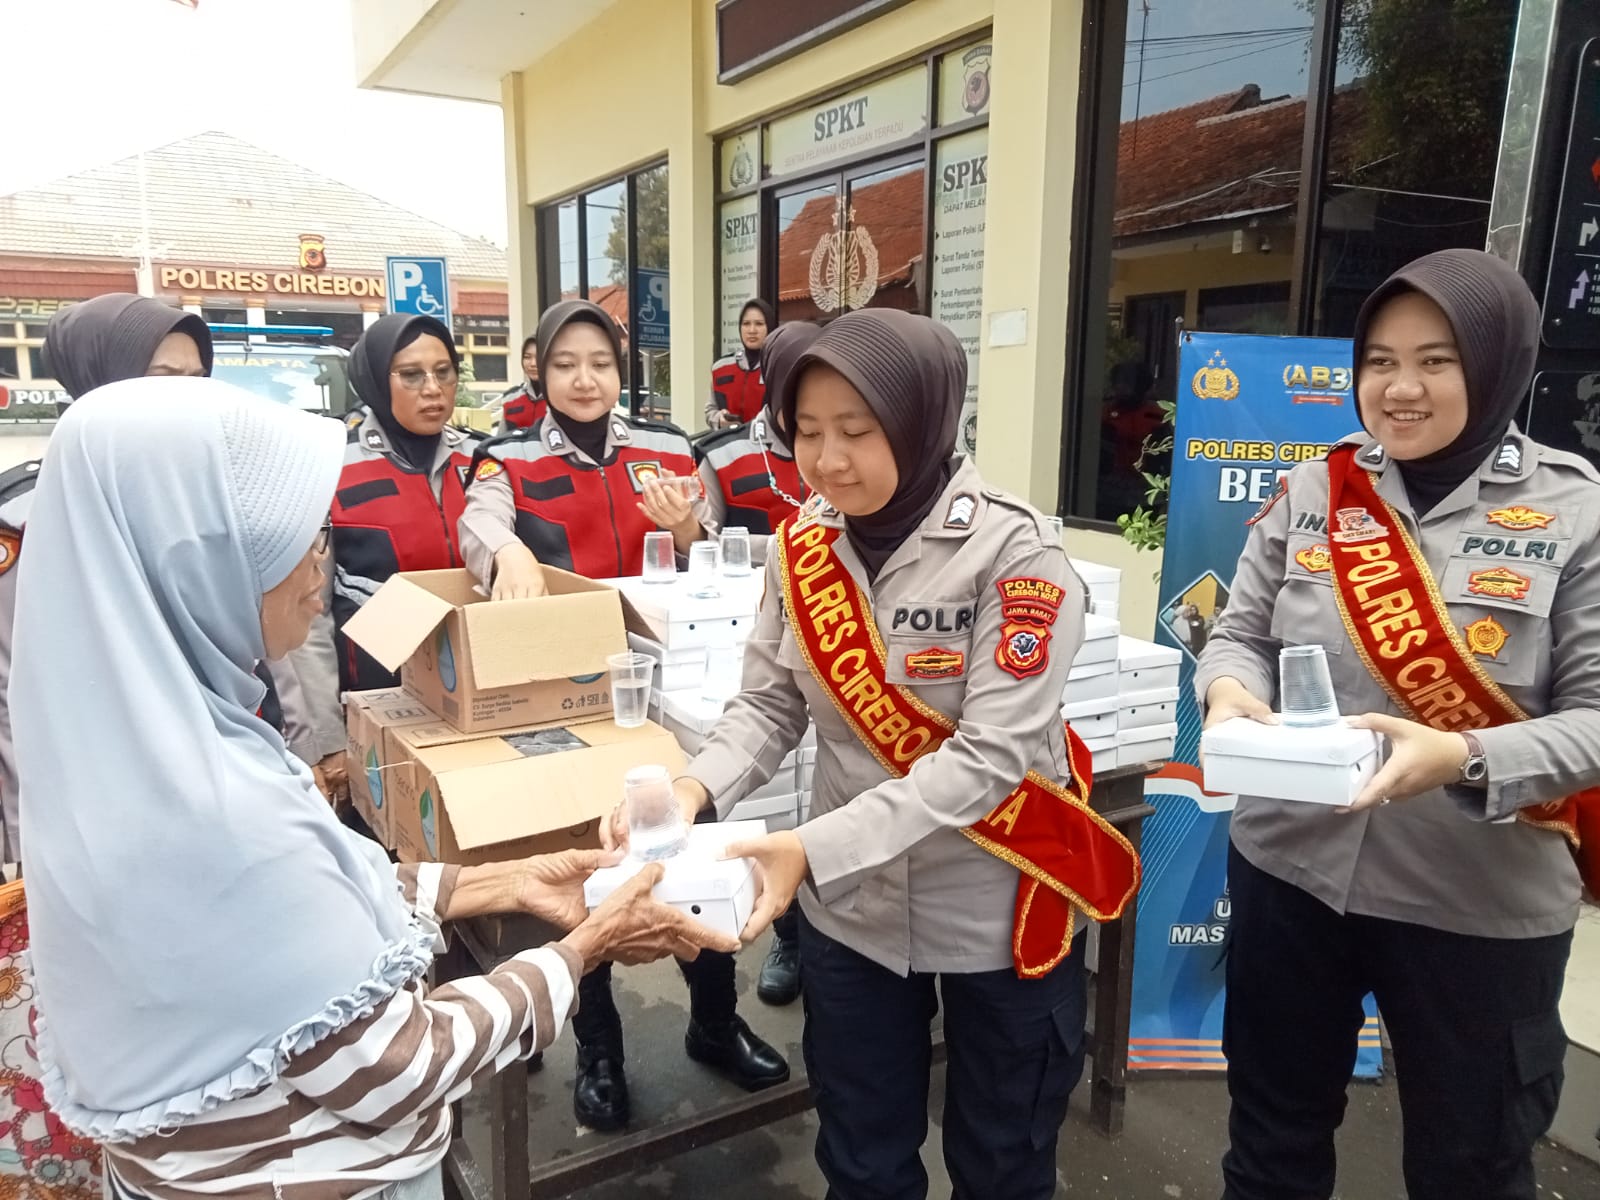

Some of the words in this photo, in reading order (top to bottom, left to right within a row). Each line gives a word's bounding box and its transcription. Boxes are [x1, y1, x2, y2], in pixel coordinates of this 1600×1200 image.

[814, 96, 868, 142] SPKT
[725, 213, 758, 239] SPKT
[161, 267, 268, 293] POLRES
[274, 272, 384, 297] CIREBON
[392, 262, 423, 301] P
[1187, 439, 1275, 461] POLRES
[1218, 466, 1289, 503] BE
[1462, 535, 1558, 560] POLRI
[1004, 580, 1061, 597] POLRES
[1006, 588, 1039, 599] CIREBON
[1340, 540, 1428, 659] POLRES
[1007, 606, 1028, 616] JAWA
[1030, 608, 1052, 620] BARAT
[792, 525, 858, 652] POLRES
[830, 648, 943, 769] CIREBO
